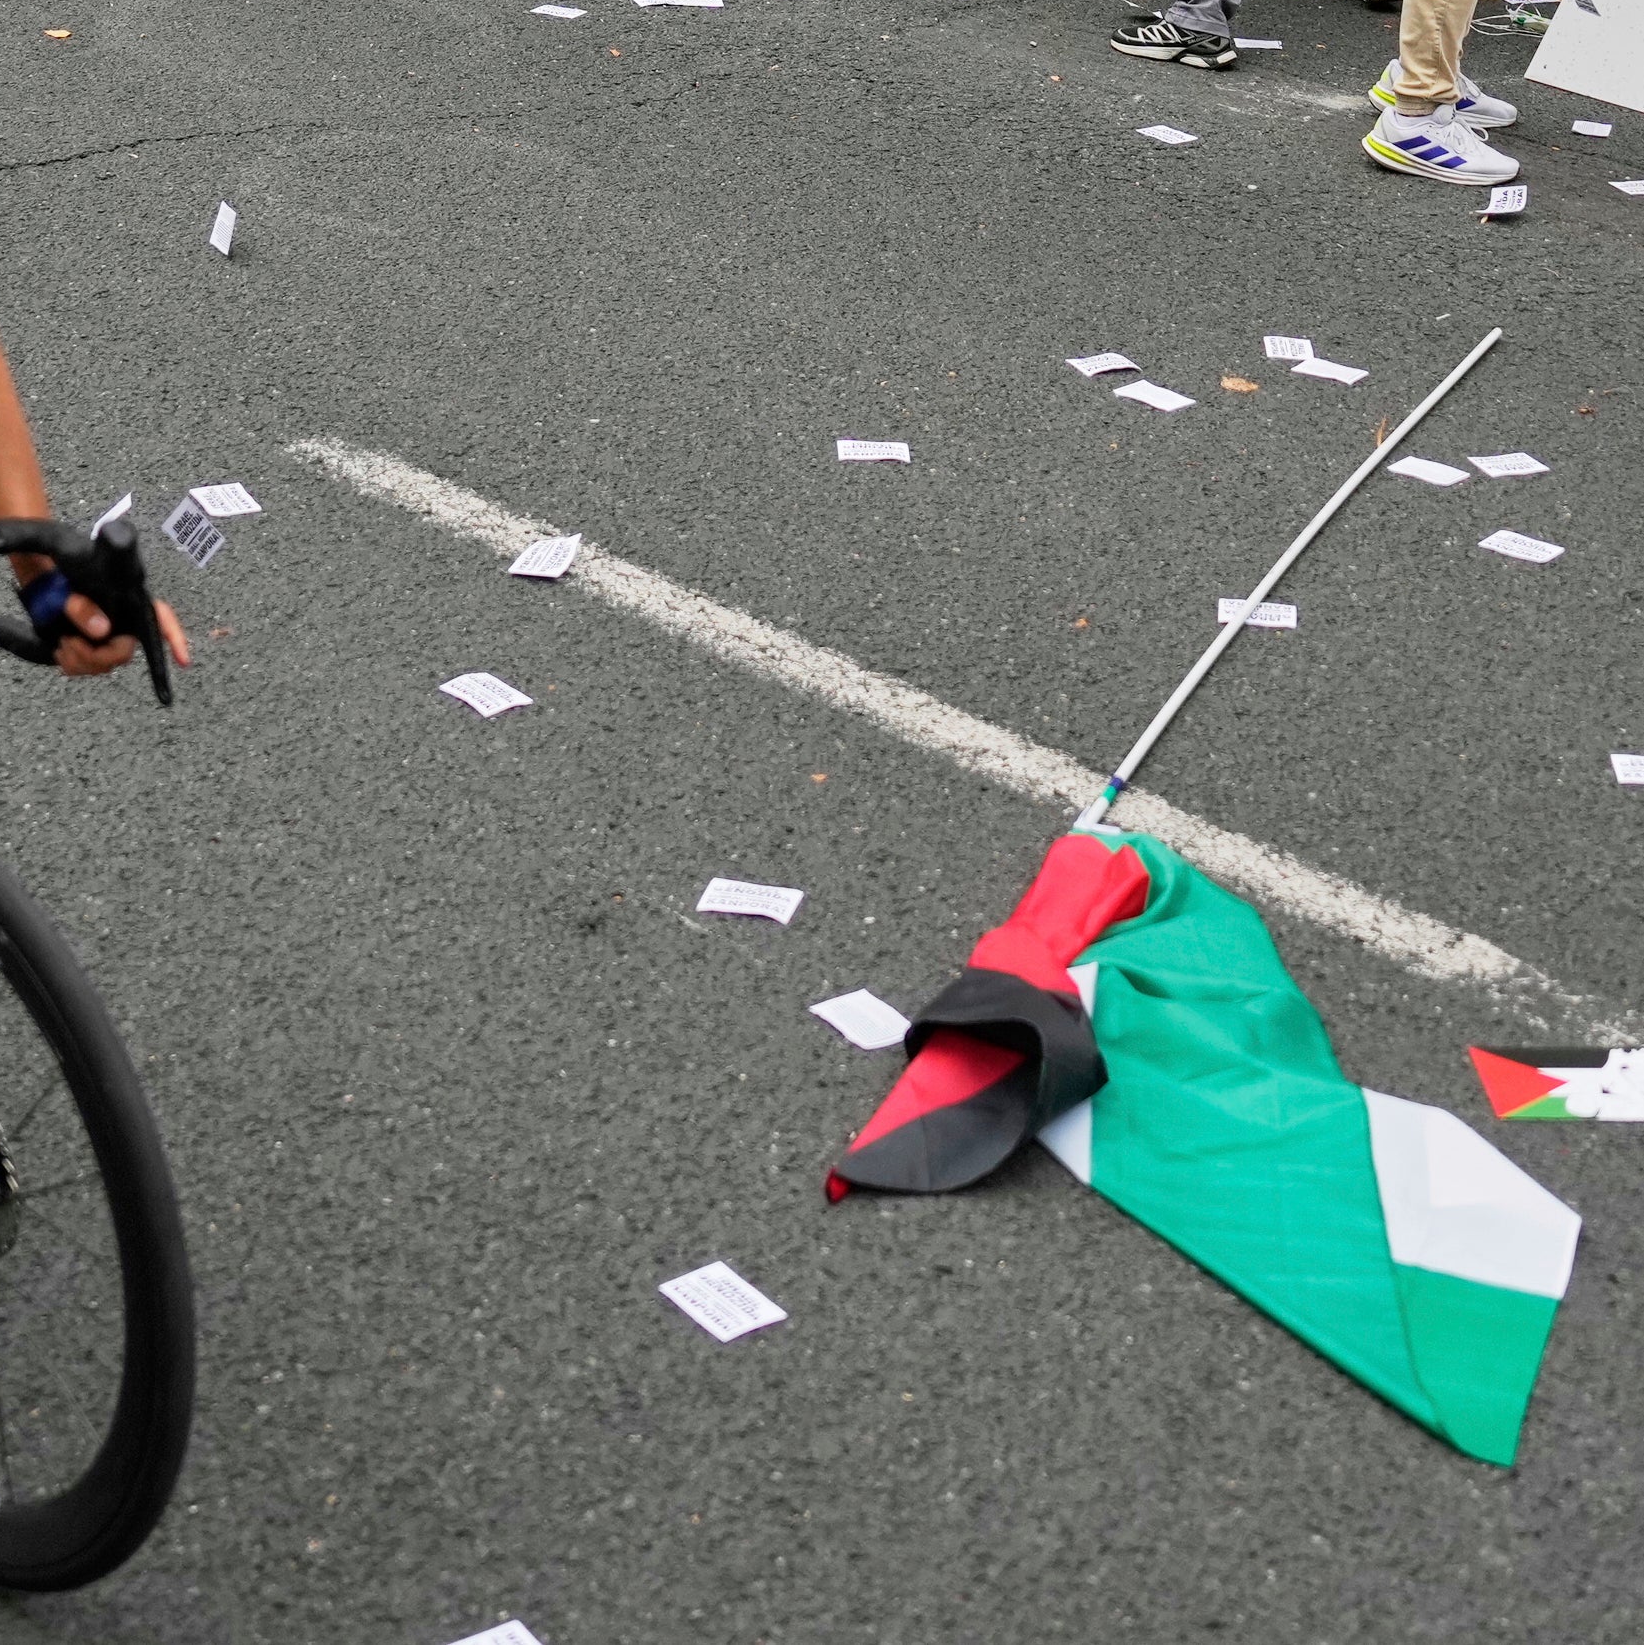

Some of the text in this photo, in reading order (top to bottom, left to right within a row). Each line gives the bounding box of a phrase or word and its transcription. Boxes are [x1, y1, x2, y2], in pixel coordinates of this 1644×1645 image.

[173, 510, 195, 532] ISRAEL
[177, 513, 205, 545] GENOZIDA
[195, 533, 220, 562] KANPORA!
